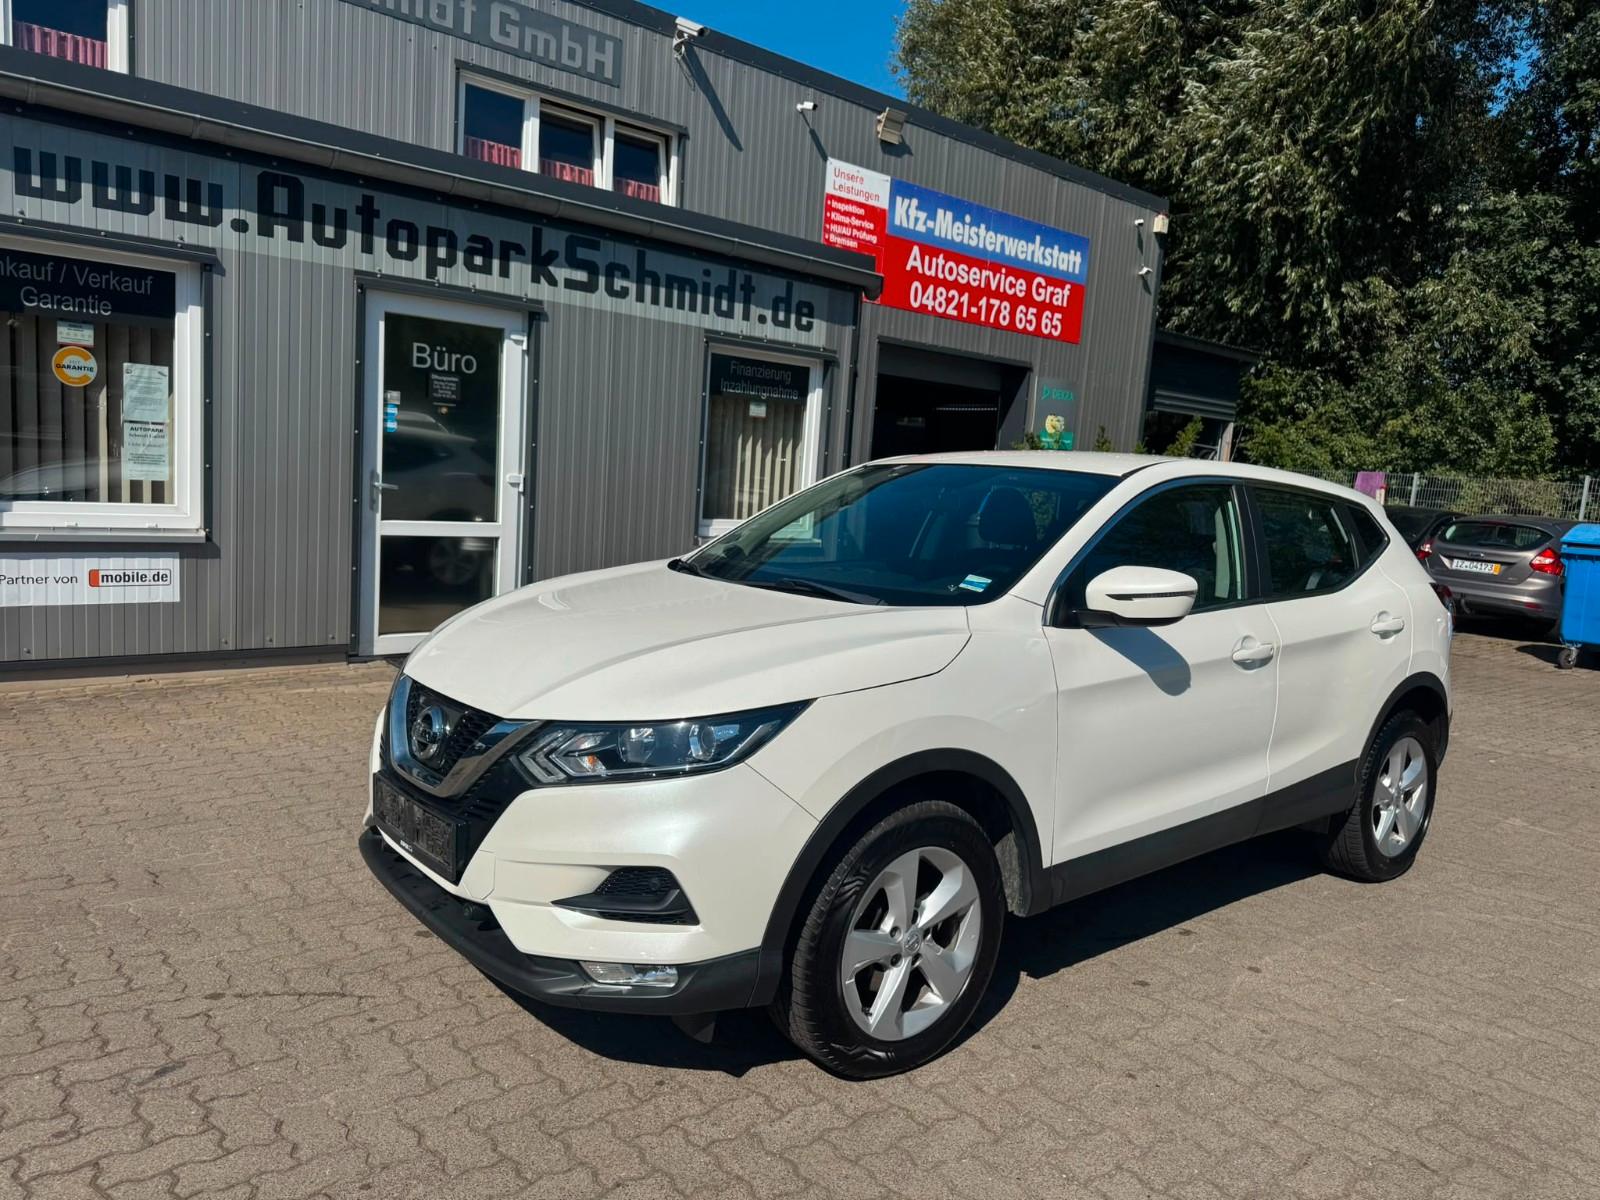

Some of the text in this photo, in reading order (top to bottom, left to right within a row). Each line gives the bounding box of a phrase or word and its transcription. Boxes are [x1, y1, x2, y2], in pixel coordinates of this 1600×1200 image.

[490, 2, 614, 80] GmbH
[833, 167, 865, 184] Unsere
[833, 180, 880, 202] Leistungen
[830, 211, 875, 230] Klima-Service
[831, 199, 865, 216] Inspektion
[13, 146, 815, 333] www.AutoparkSchmidt.de
[829, 233, 859, 248] Bremsen
[894, 195, 1082, 275] Kfz-Meisterwerkstatt
[73, 265, 153, 295] Verkauf
[905, 244, 1072, 308] Autoservice Graf
[20, 286, 112, 316] Garantie
[909, 280, 1063, 337] 04821-178 65 65
[56, 363, 94, 373] GARANTIE
[412, 342, 477, 374] Büro
[731, 361, 792, 385] Finanzierung
[0, 572, 169, 585] Partner von mobile.de
